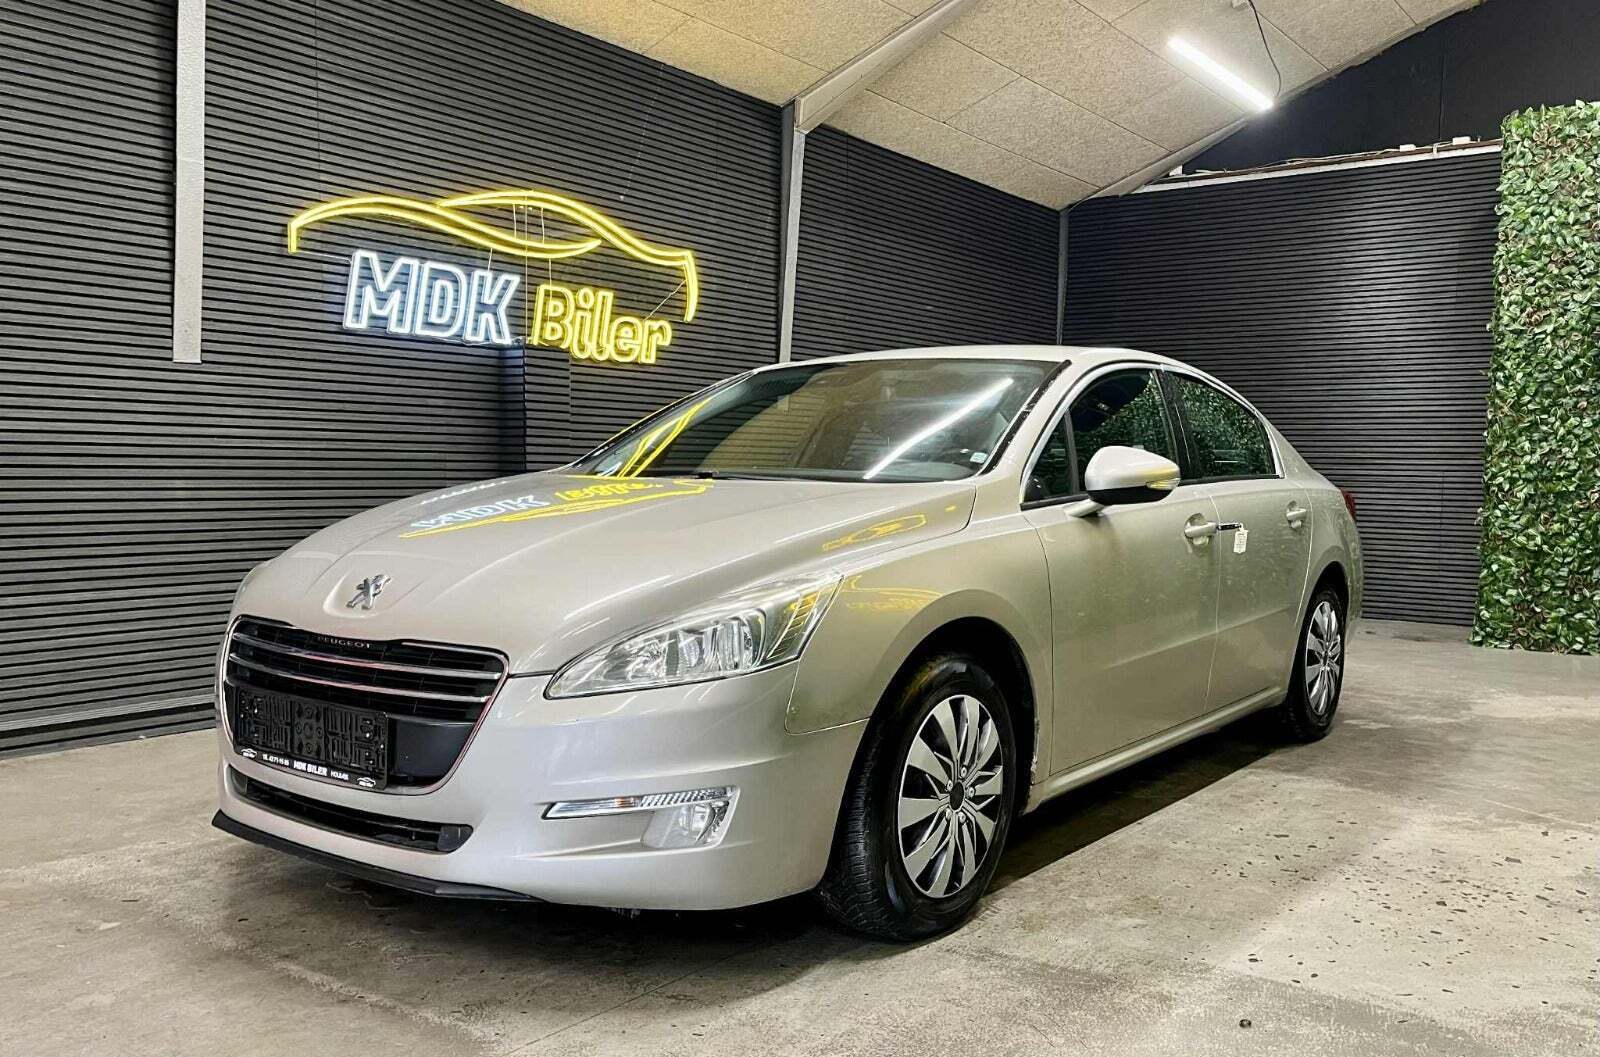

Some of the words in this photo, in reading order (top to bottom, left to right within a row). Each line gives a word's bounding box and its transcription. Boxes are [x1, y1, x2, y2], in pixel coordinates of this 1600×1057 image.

[342, 249, 519, 345] MDK
[532, 284, 672, 364] Biler
[307, 764, 327, 776] BILER
